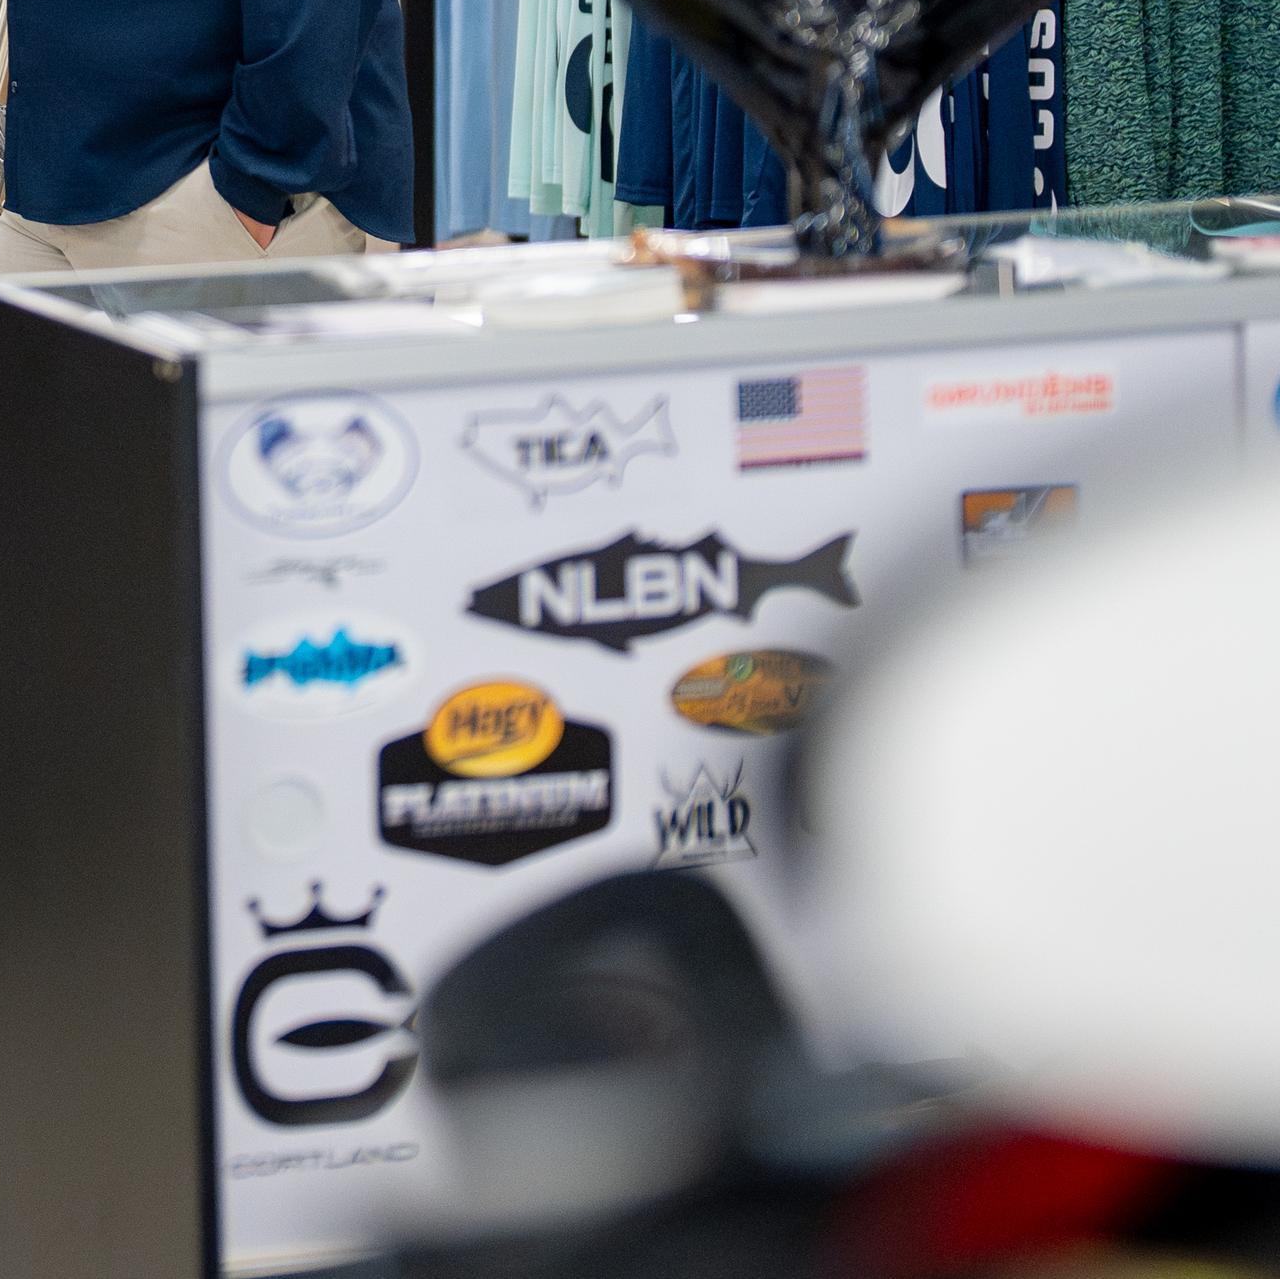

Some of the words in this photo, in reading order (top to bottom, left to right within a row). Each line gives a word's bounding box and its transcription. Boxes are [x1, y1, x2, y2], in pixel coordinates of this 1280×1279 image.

[518, 549, 740, 628] NLBN
[382, 770, 609, 828] PLATINUM
[655, 797, 751, 851] WILD
